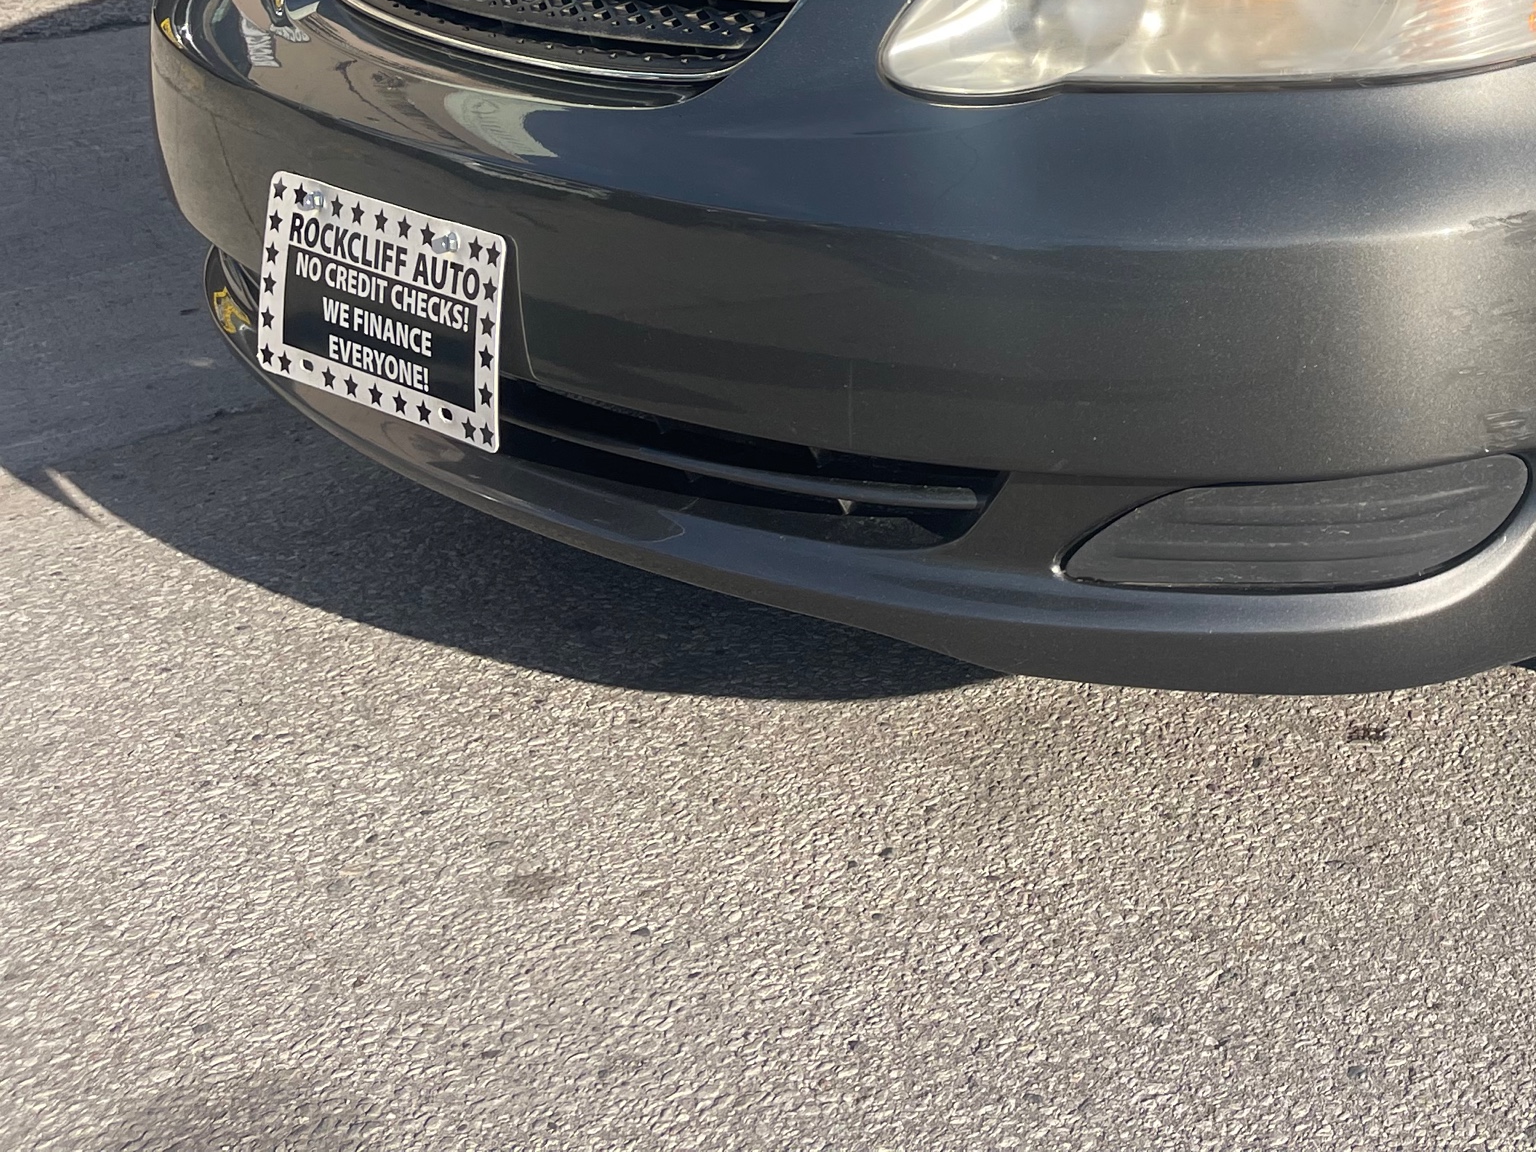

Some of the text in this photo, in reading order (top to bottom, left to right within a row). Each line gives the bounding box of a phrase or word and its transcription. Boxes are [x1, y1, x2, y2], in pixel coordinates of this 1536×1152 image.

[289, 211, 481, 301] ROCKCLIFF AUTO
[295, 251, 470, 333] NO CREDIT CHECKS!
[322, 296, 432, 358] WE FINANCE
[328, 334, 431, 393] EVERYONE!
